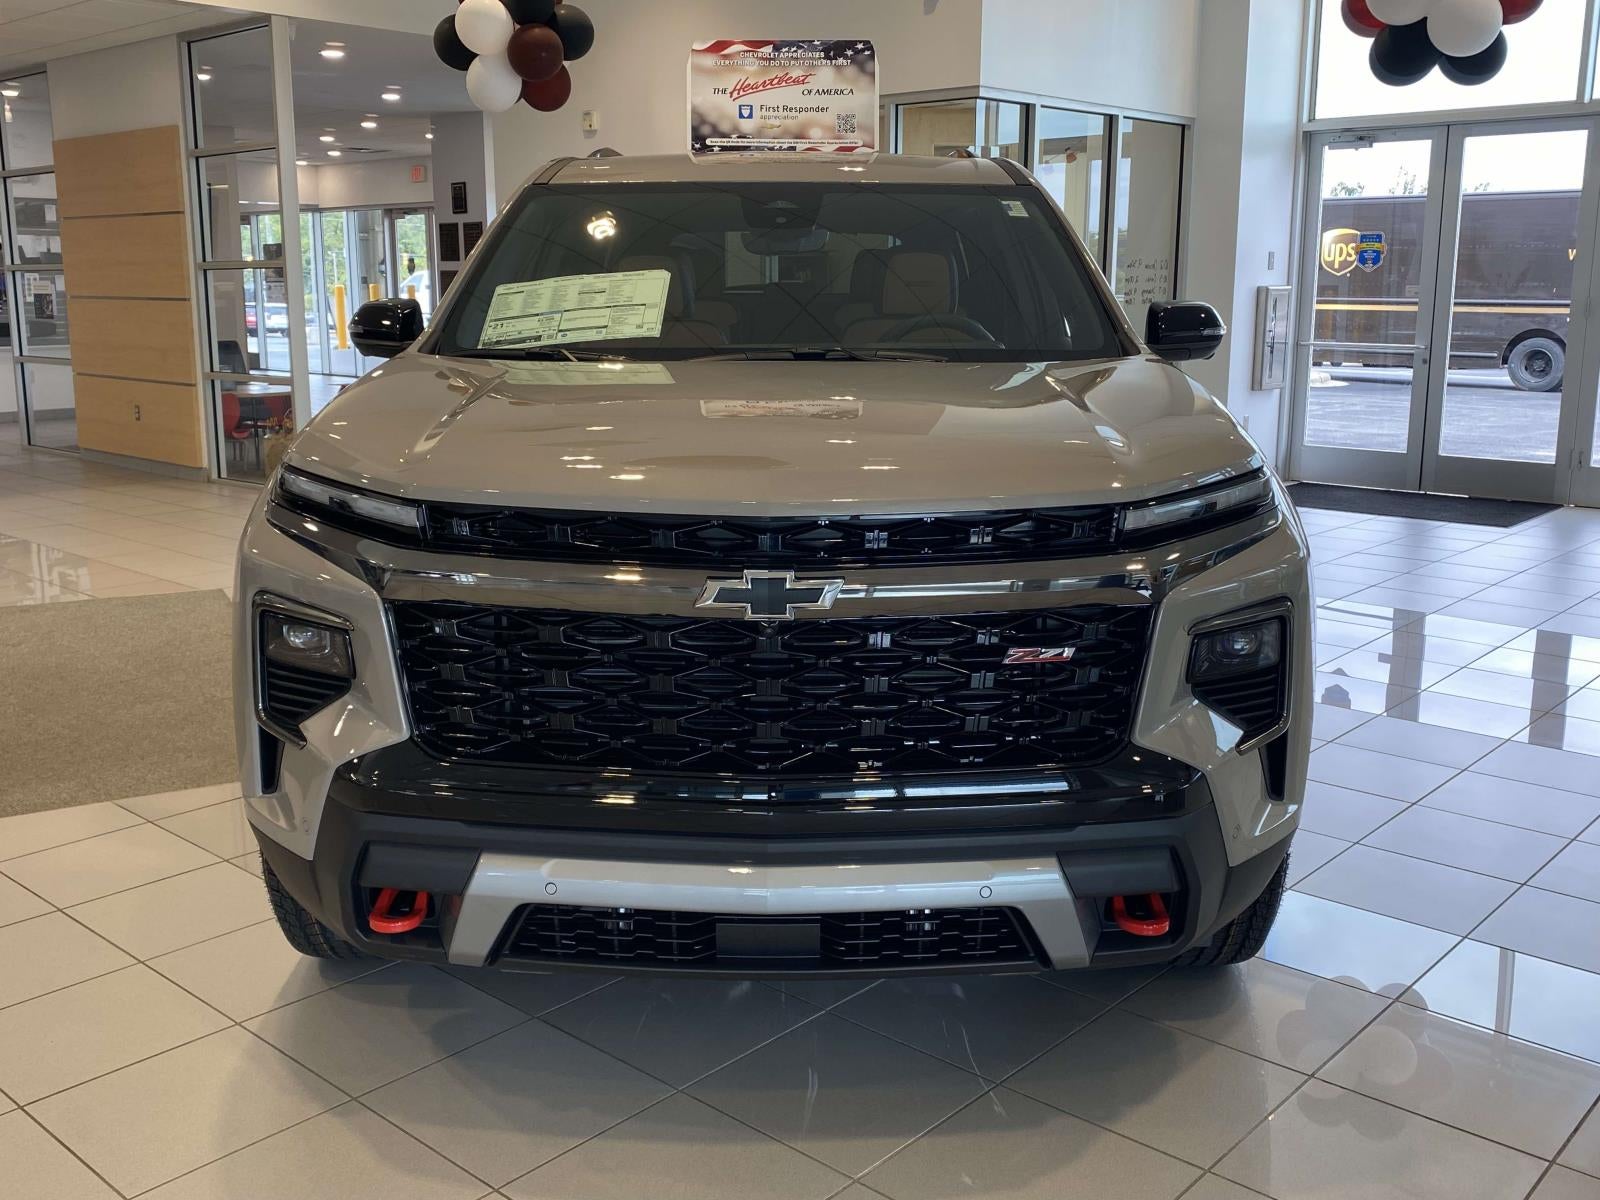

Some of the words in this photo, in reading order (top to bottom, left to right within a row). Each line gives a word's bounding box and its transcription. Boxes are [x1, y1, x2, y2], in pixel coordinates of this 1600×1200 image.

[712, 87, 729, 95] THE
[729, 72, 816, 100] Heartbeat
[802, 88, 817, 96] OF
[816, 88, 854, 96] AMERICA
[760, 104, 780, 113] First
[782, 104, 829, 115] Responder
[1323, 243, 1356, 269] ups
[1001, 647, 1076, 664] Z71
